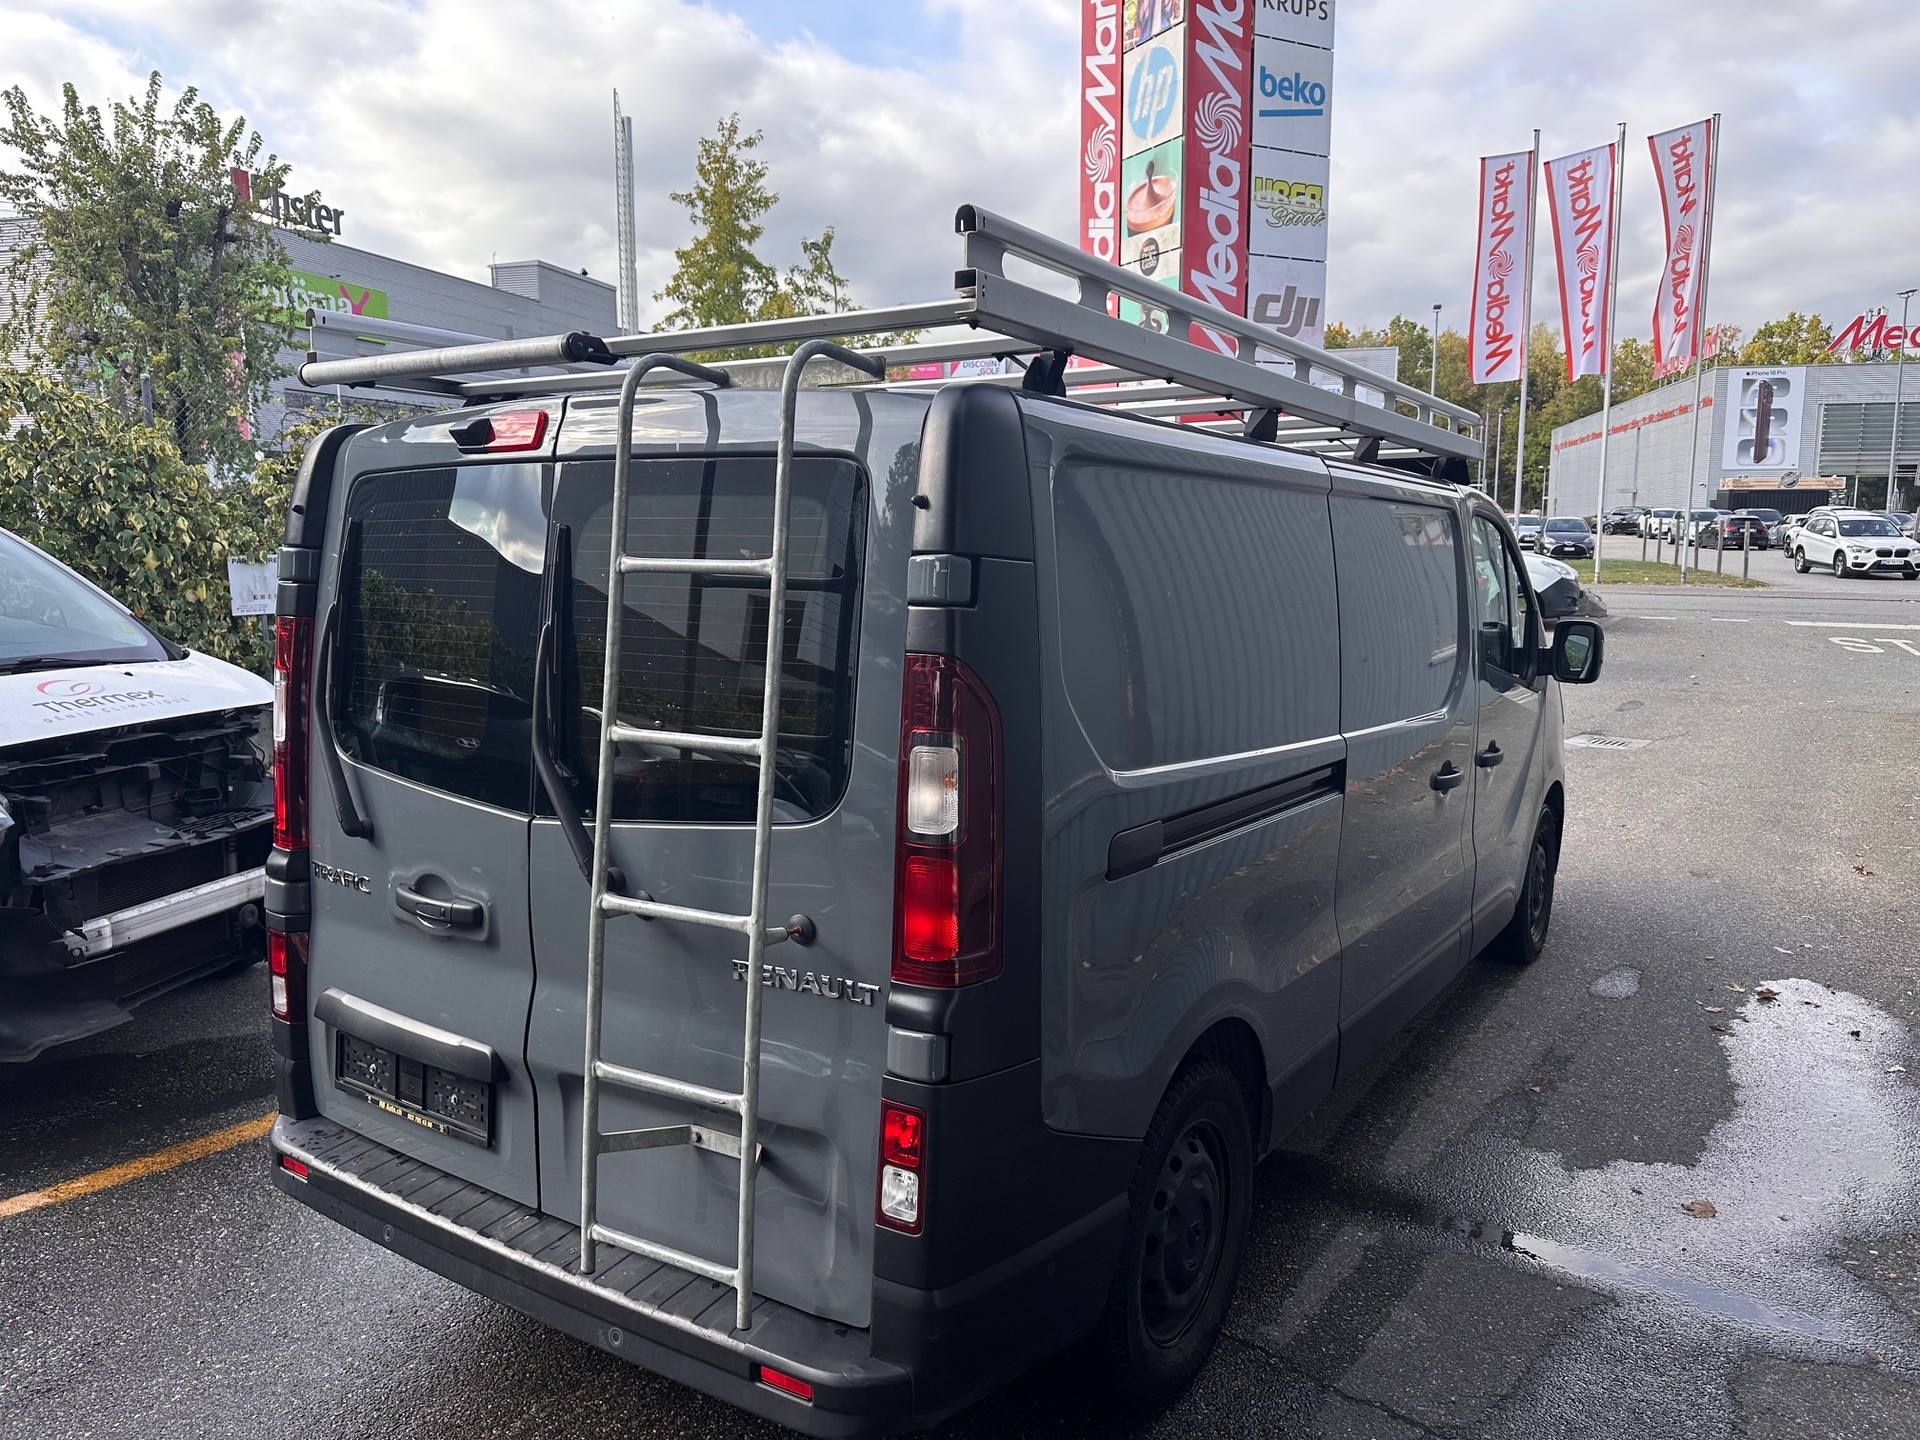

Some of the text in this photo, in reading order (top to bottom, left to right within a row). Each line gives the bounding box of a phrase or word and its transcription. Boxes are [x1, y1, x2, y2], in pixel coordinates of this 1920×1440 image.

[1260, 65, 1326, 106] beko
[32, 690, 165, 713] Thermex
[311, 860, 372, 895] TRAFIC
[732, 958, 882, 1007] RENAULT
